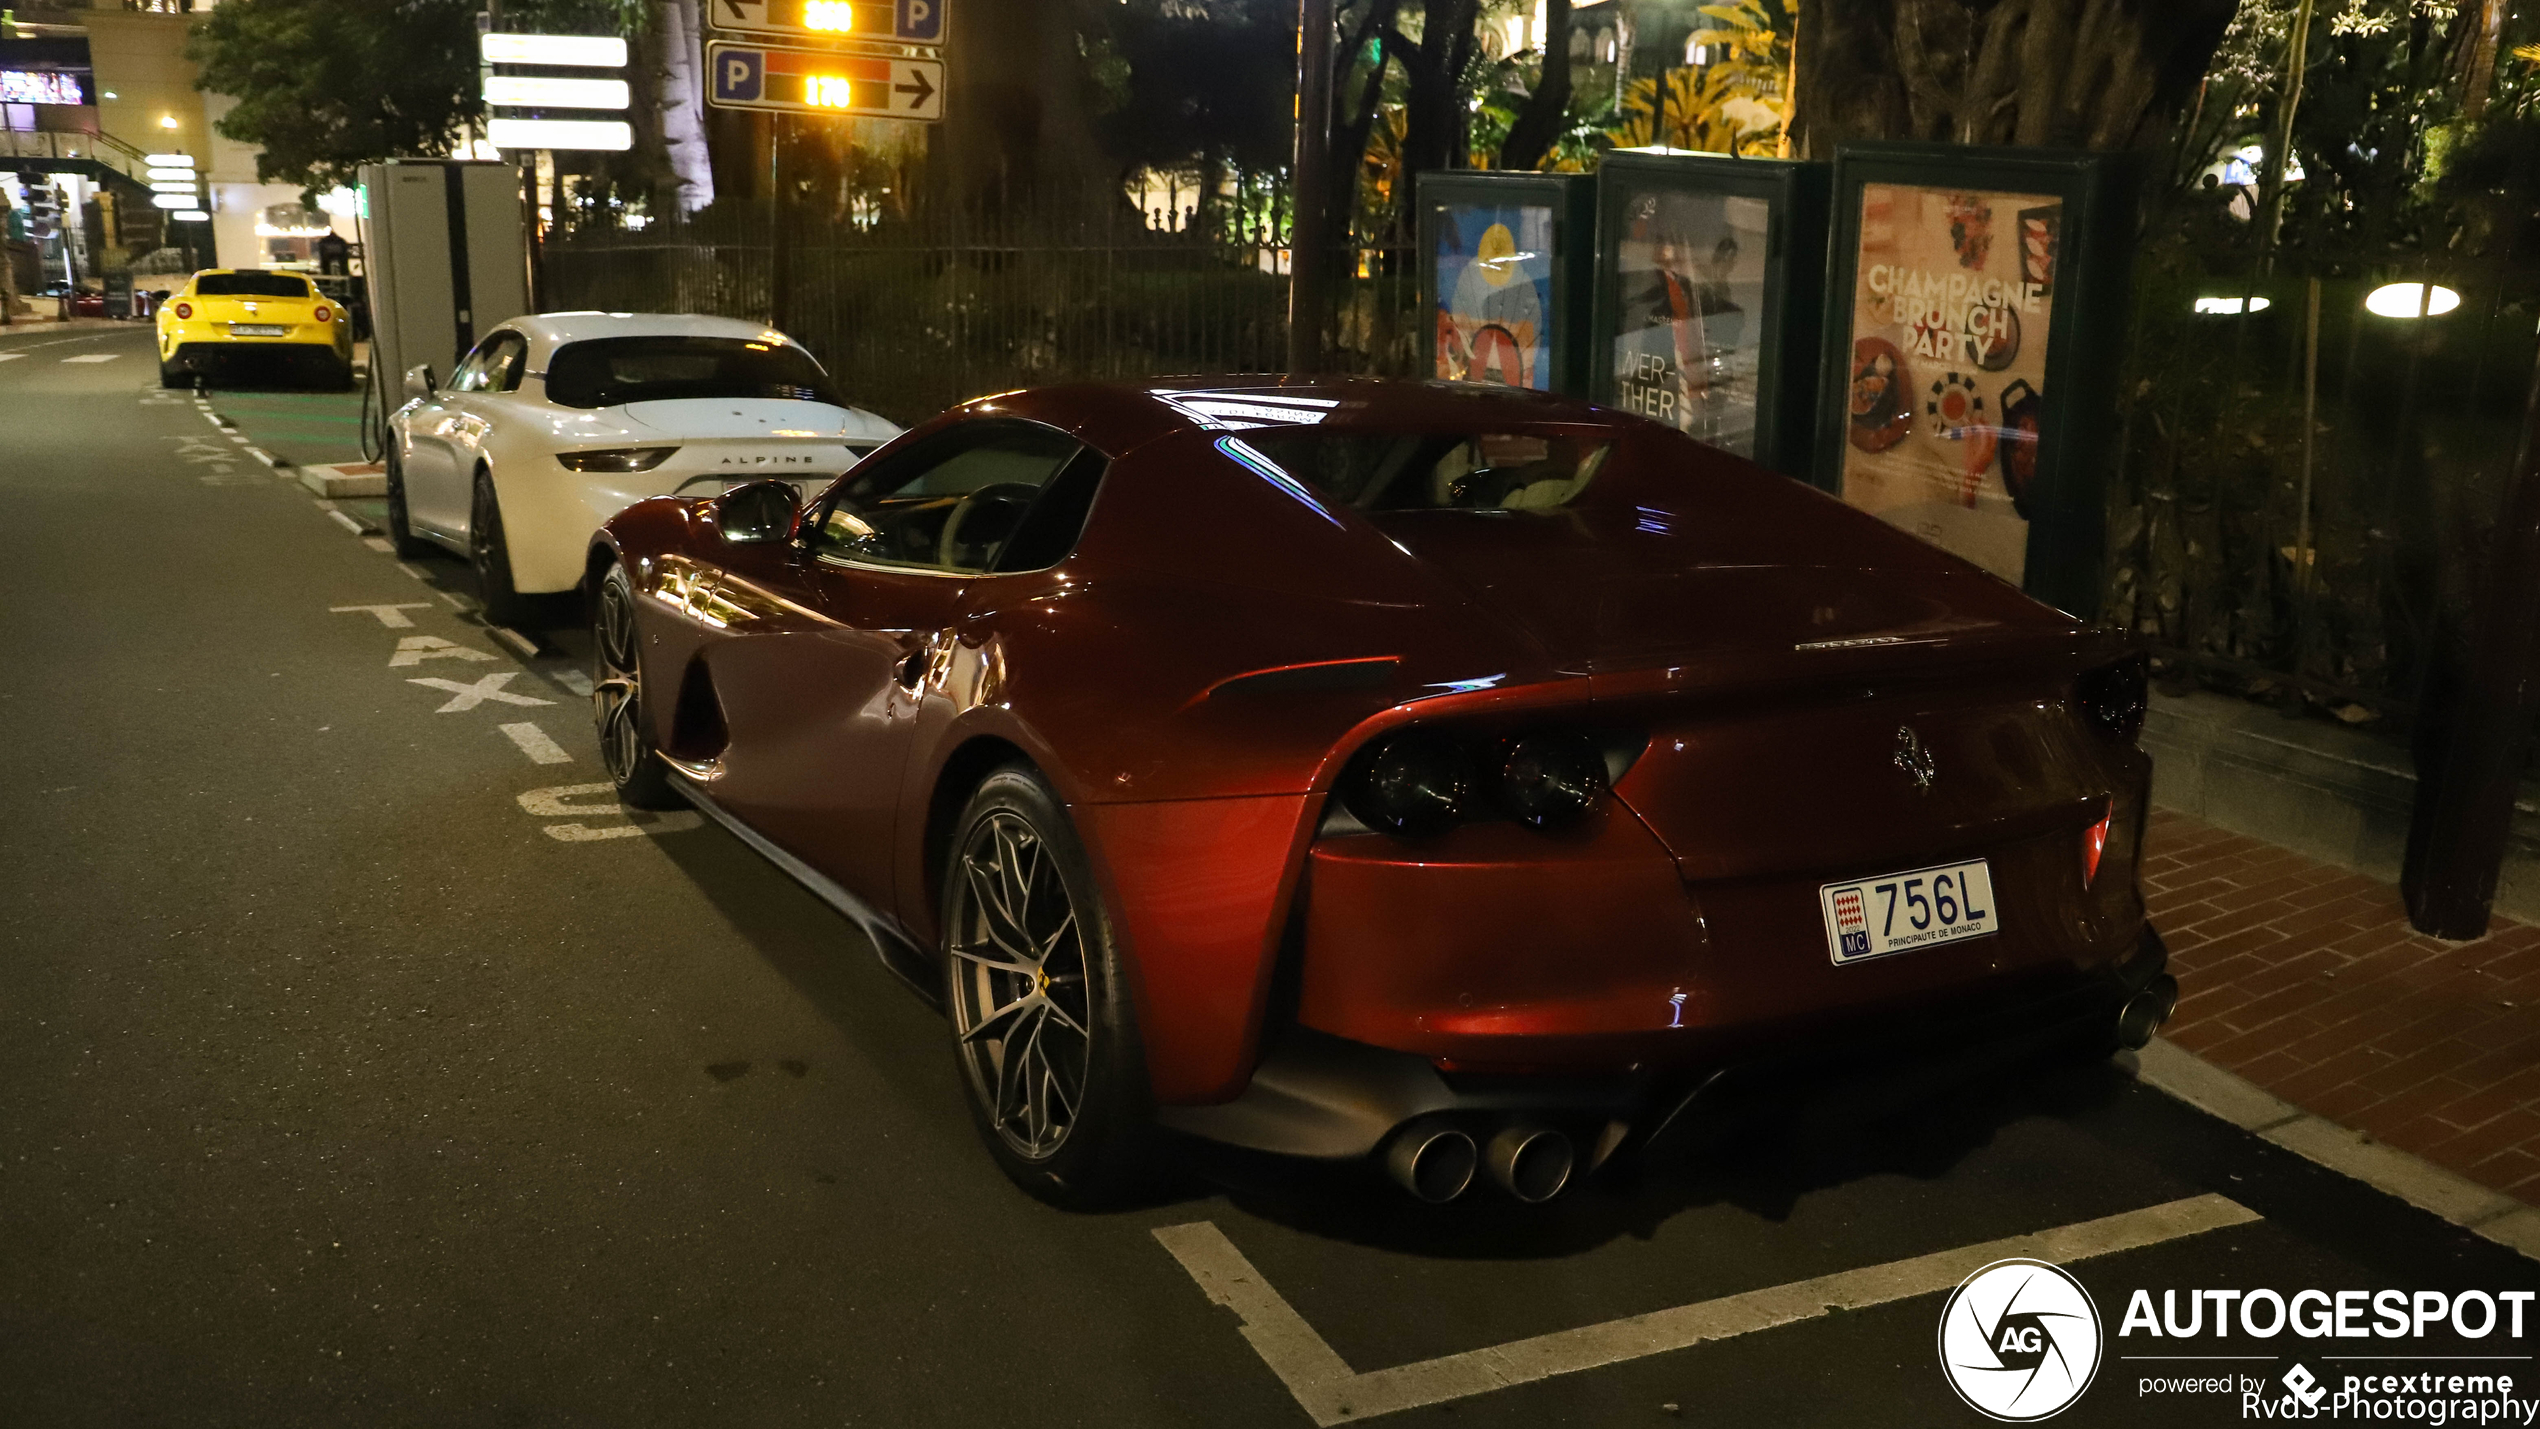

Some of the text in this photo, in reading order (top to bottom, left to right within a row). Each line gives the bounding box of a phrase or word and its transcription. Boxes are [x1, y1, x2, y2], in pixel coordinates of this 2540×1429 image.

[908, 0, 929, 29] P
[727, 60, 750, 91] P
[1868, 263, 2043, 314] CHAMPAGNE
[1893, 295, 2009, 340] BRUNCH
[1903, 326, 1994, 366] PARTY
[1621, 380, 1675, 420] THER
[721, 456, 814, 464] ALPINE
[331, 604, 706, 842] TAXIS
[1876, 871, 1985, 936] 756L
[1845, 934, 1866, 952] MC
[1888, 922, 1981, 947] PRINCIPAUTE DE MONACO
